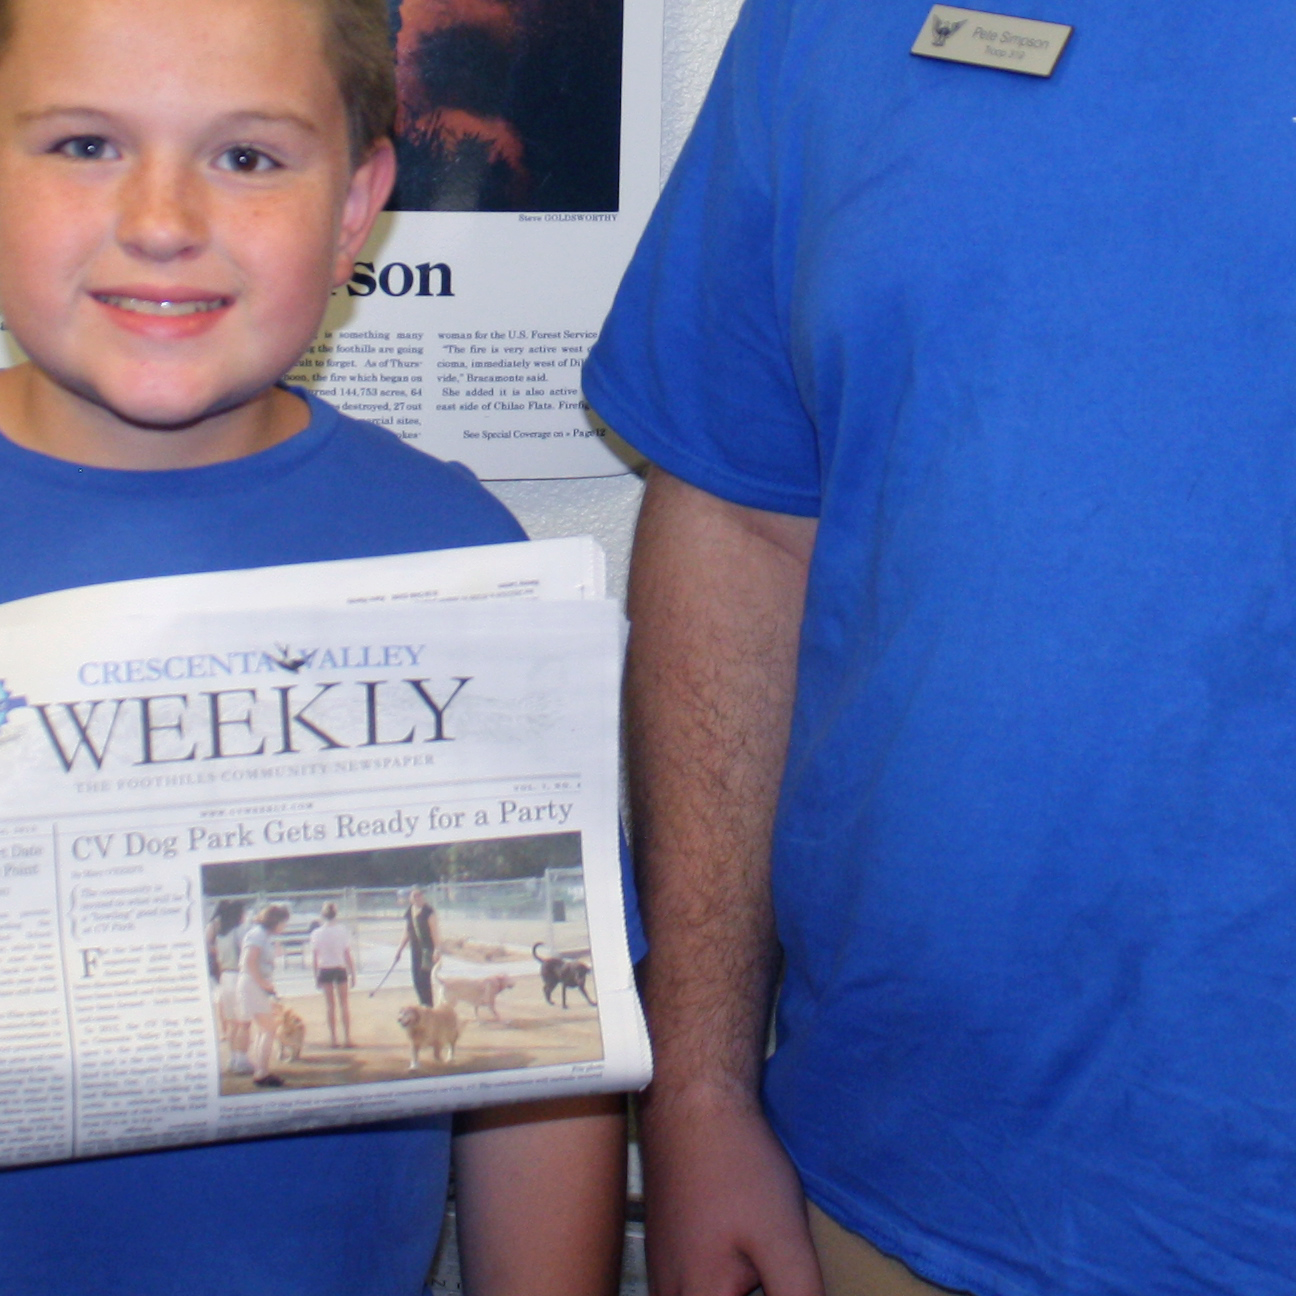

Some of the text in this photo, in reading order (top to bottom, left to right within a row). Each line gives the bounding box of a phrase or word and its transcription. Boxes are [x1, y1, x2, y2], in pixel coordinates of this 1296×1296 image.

[972, 27, 1050, 49] Pete Simpson
[518, 214, 618, 222] Steve GOLDSWORTHY
[332, 262, 455, 296] son
[474, 330, 488, 339] for
[490, 331, 506, 340] the
[508, 330, 529, 339] U.S.
[531, 330, 561, 339] Forest
[563, 330, 598, 340] Service
[410, 388, 422, 397] 64
[463, 430, 480, 439] See
[481, 430, 512, 440] Special
[513, 430, 551, 440] Coverage
[572, 428, 595, 438] Page
[78, 644, 426, 687] CRESCENTA VALLEY
[33, 677, 475, 773] WEEKLY
[73, 752, 439, 793] THE FOOTHILLS COMMUNITY NEWSPAPER
[71, 797, 574, 861] CV Dog Park Gets Ready for a Party
